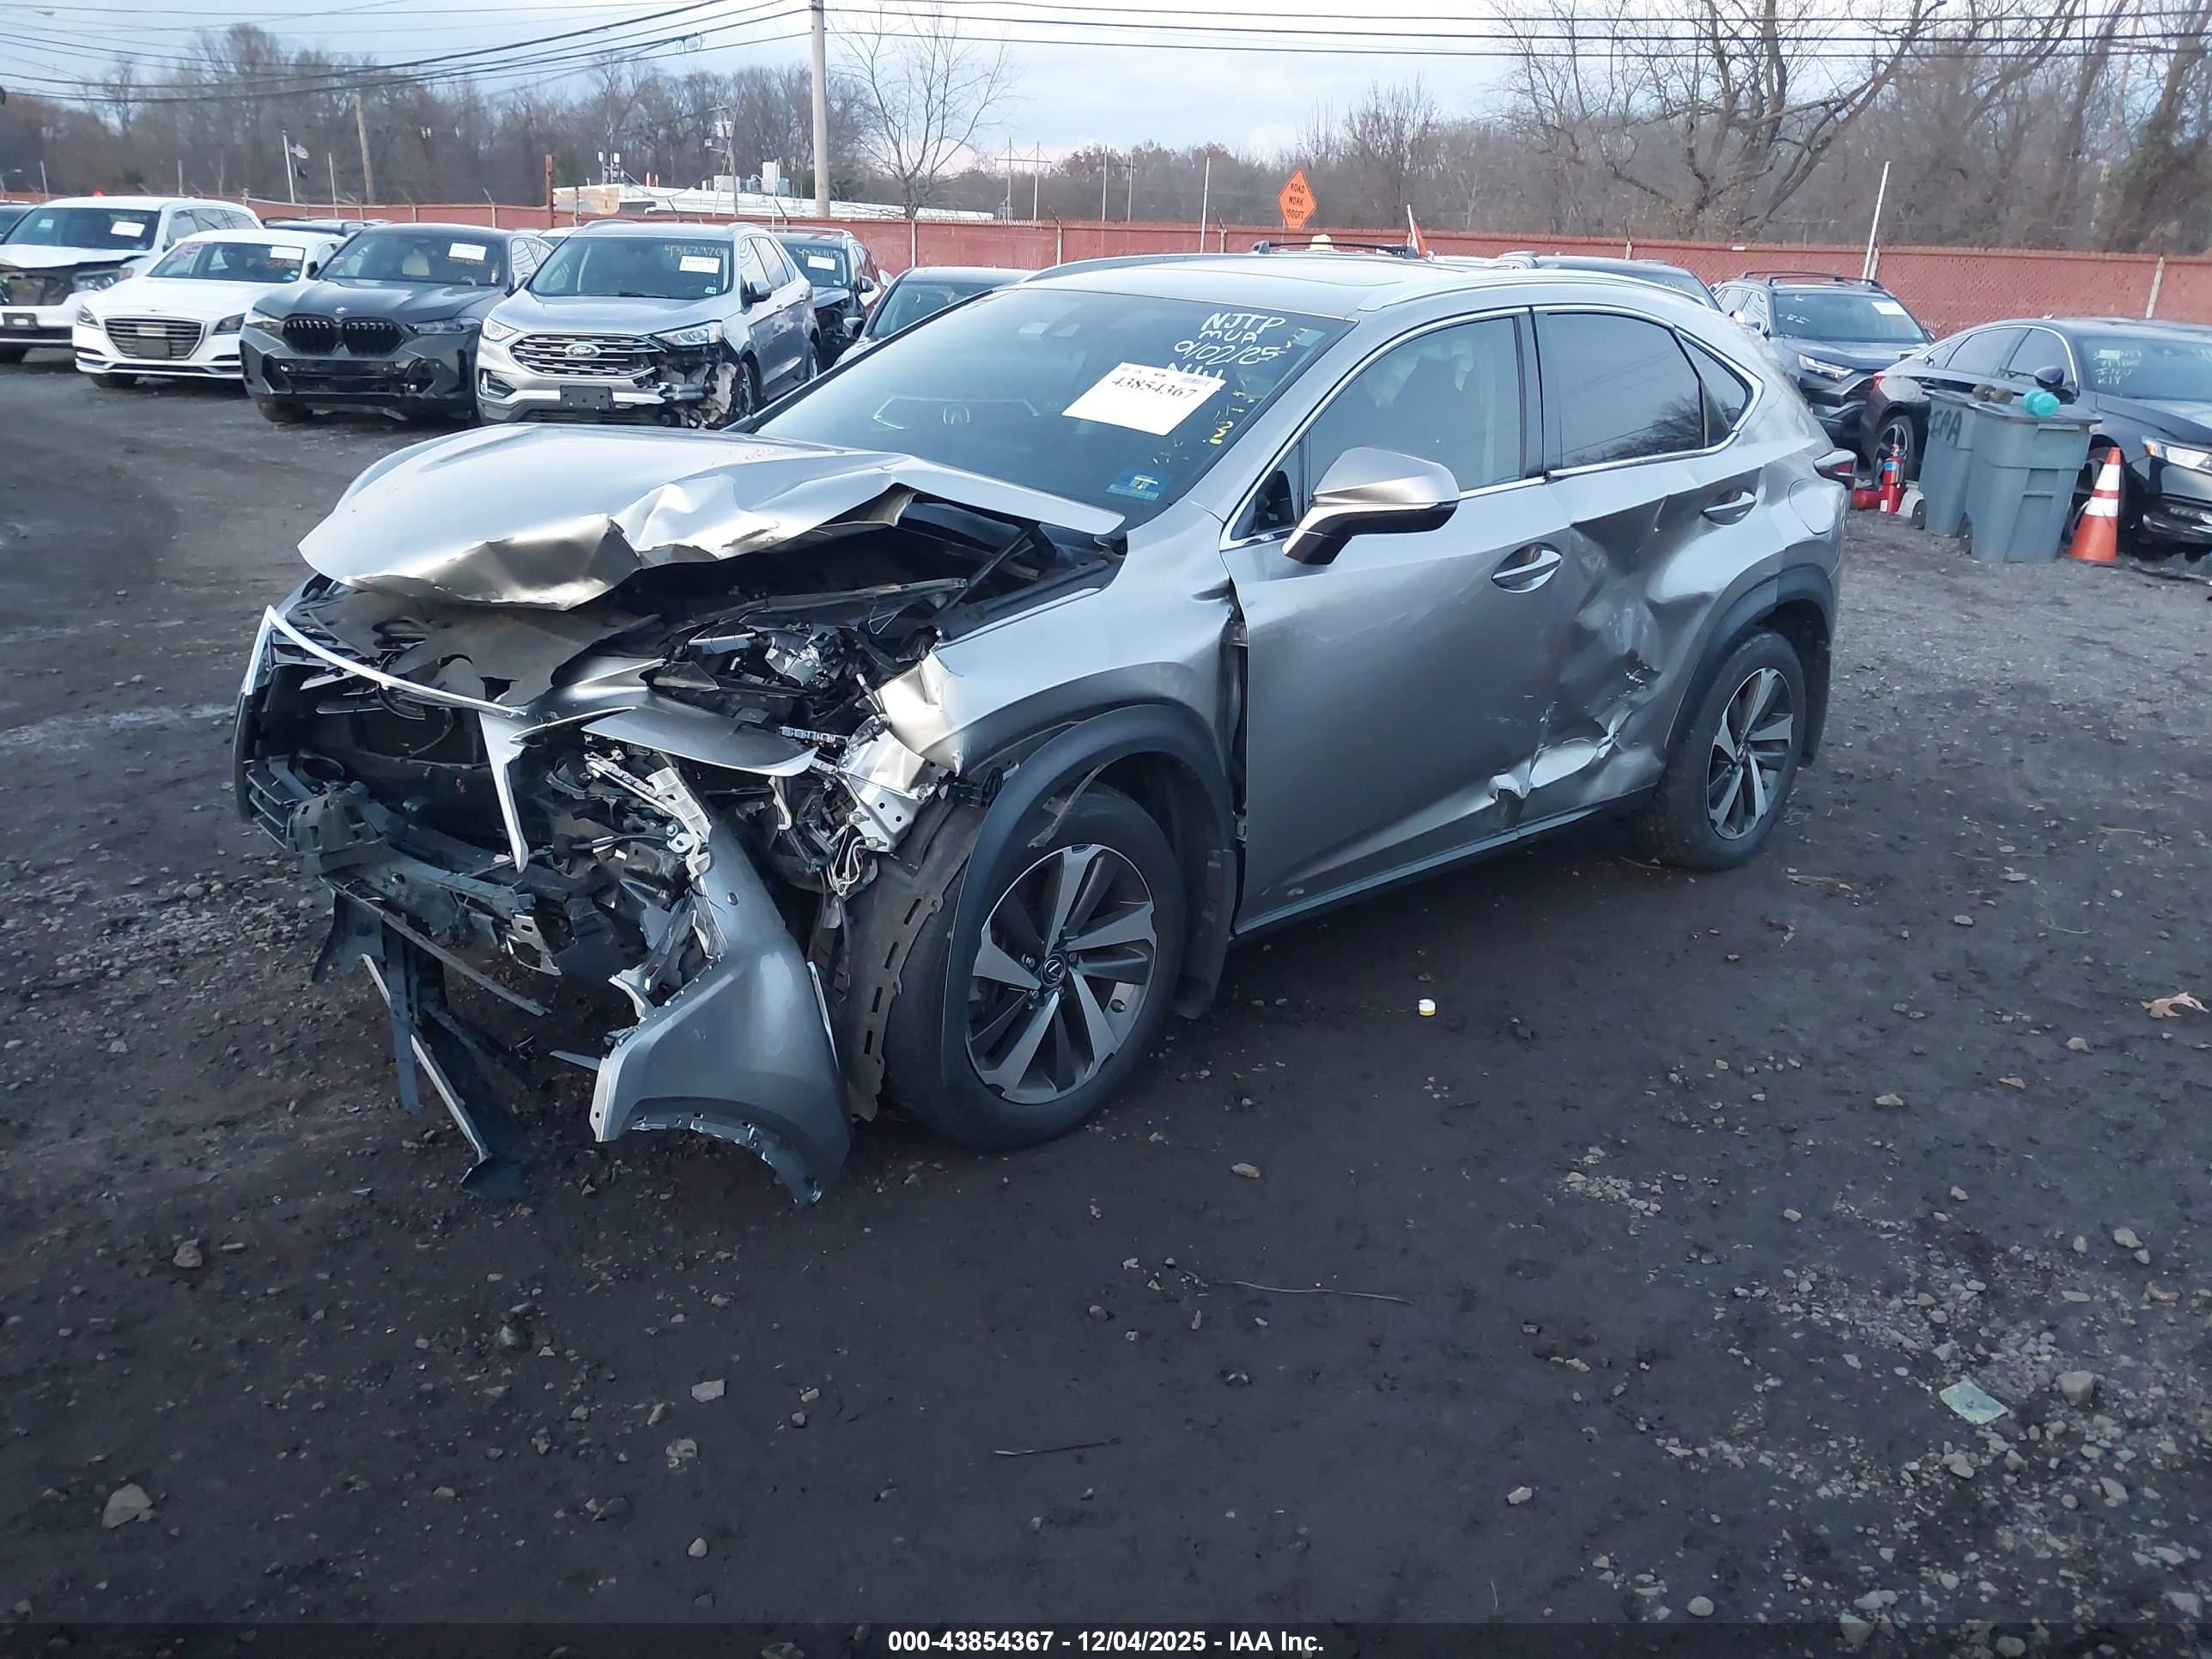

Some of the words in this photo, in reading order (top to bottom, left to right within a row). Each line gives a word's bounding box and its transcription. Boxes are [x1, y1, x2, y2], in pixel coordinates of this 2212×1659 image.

[1291, 183, 1305, 194] ROAD
[1289, 197, 1304, 206] WORK
[1200, 313, 1286, 334] NJTP
[1198, 330, 1257, 344] MUA
[1112, 376, 1199, 399] 43854367
